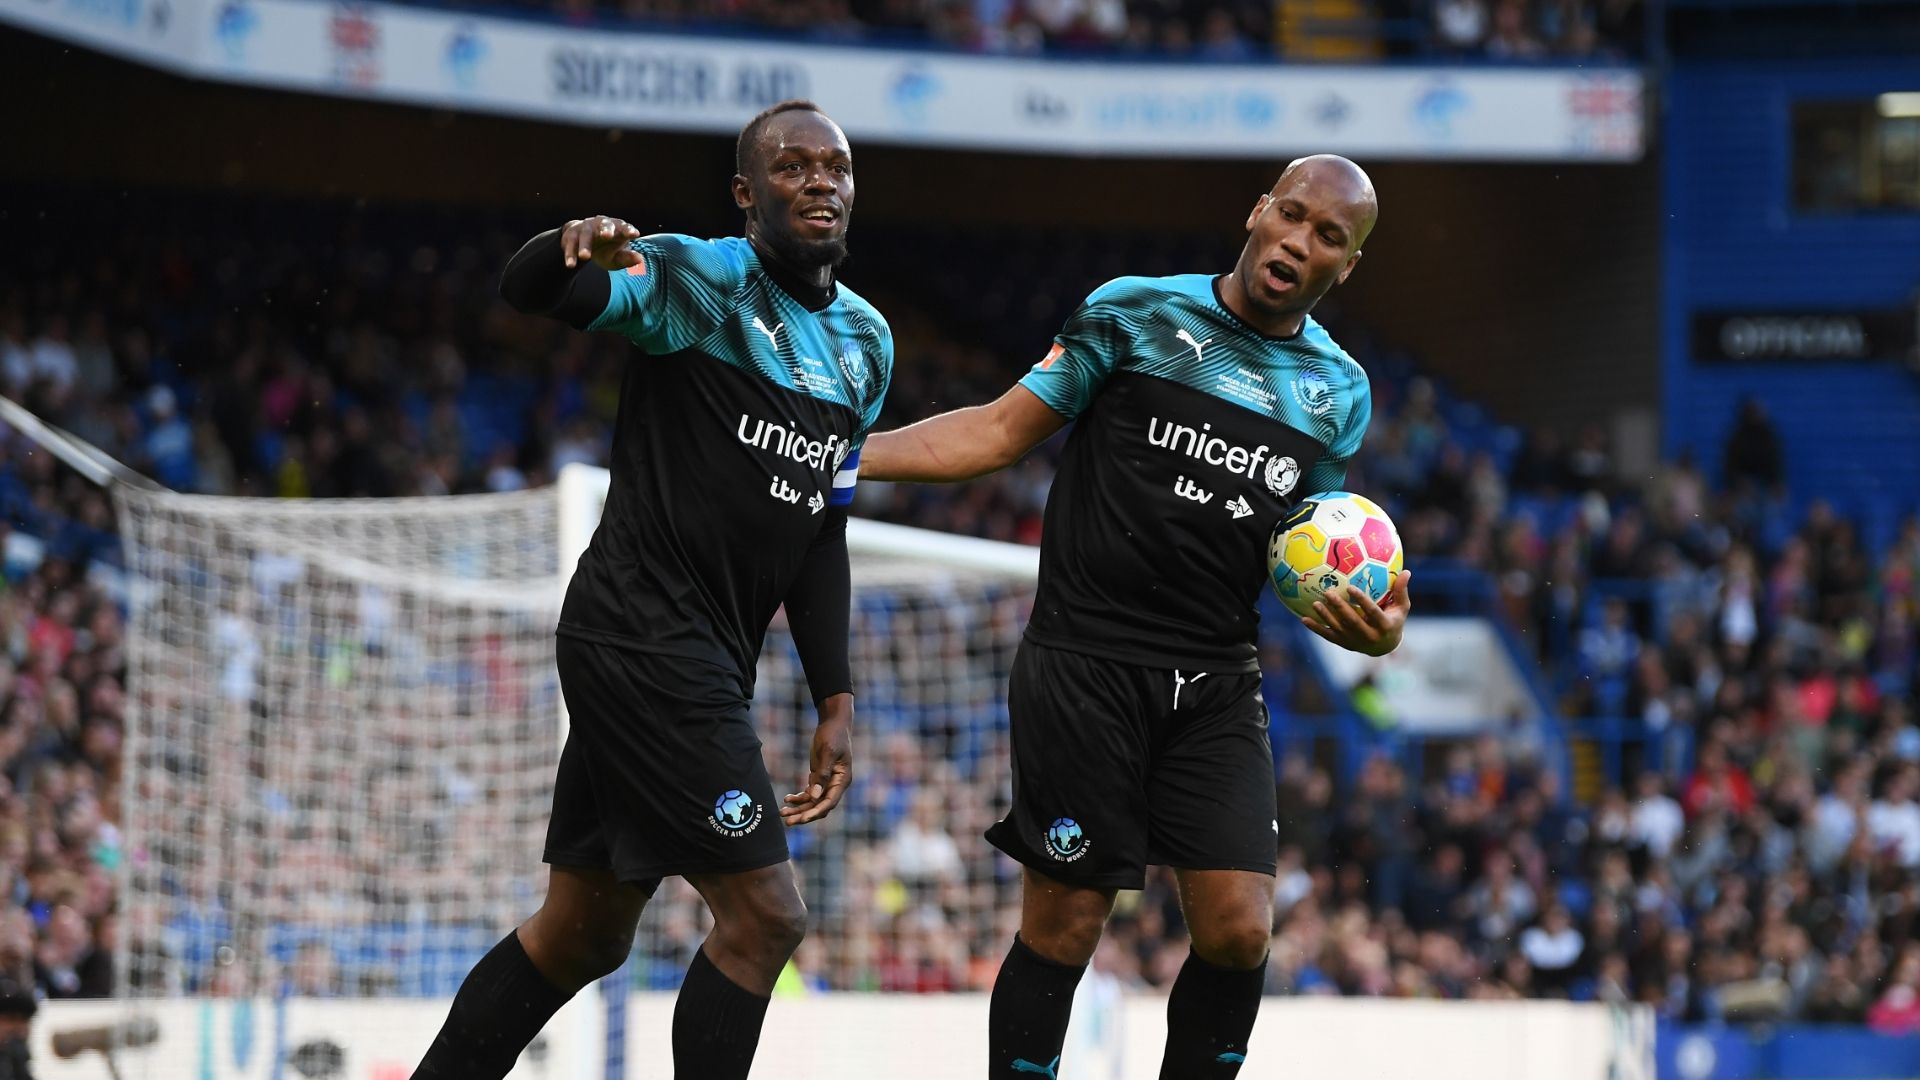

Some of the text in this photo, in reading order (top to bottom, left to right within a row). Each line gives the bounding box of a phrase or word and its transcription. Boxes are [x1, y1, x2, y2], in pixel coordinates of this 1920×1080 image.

[549, 45, 721, 102] SOCCER
[1238, 368, 1264, 382] ENGLAND
[737, 414, 838, 471] unicef
[1148, 417, 1270, 479] unicef
[769, 475, 802, 504] itv
[1173, 475, 1214, 504] itv
[708, 815, 729, 836] SOCCER
[745, 813, 762, 834] WORLD
[1054, 854, 1065, 862] AID
[1066, 847, 1087, 863] WORLD
